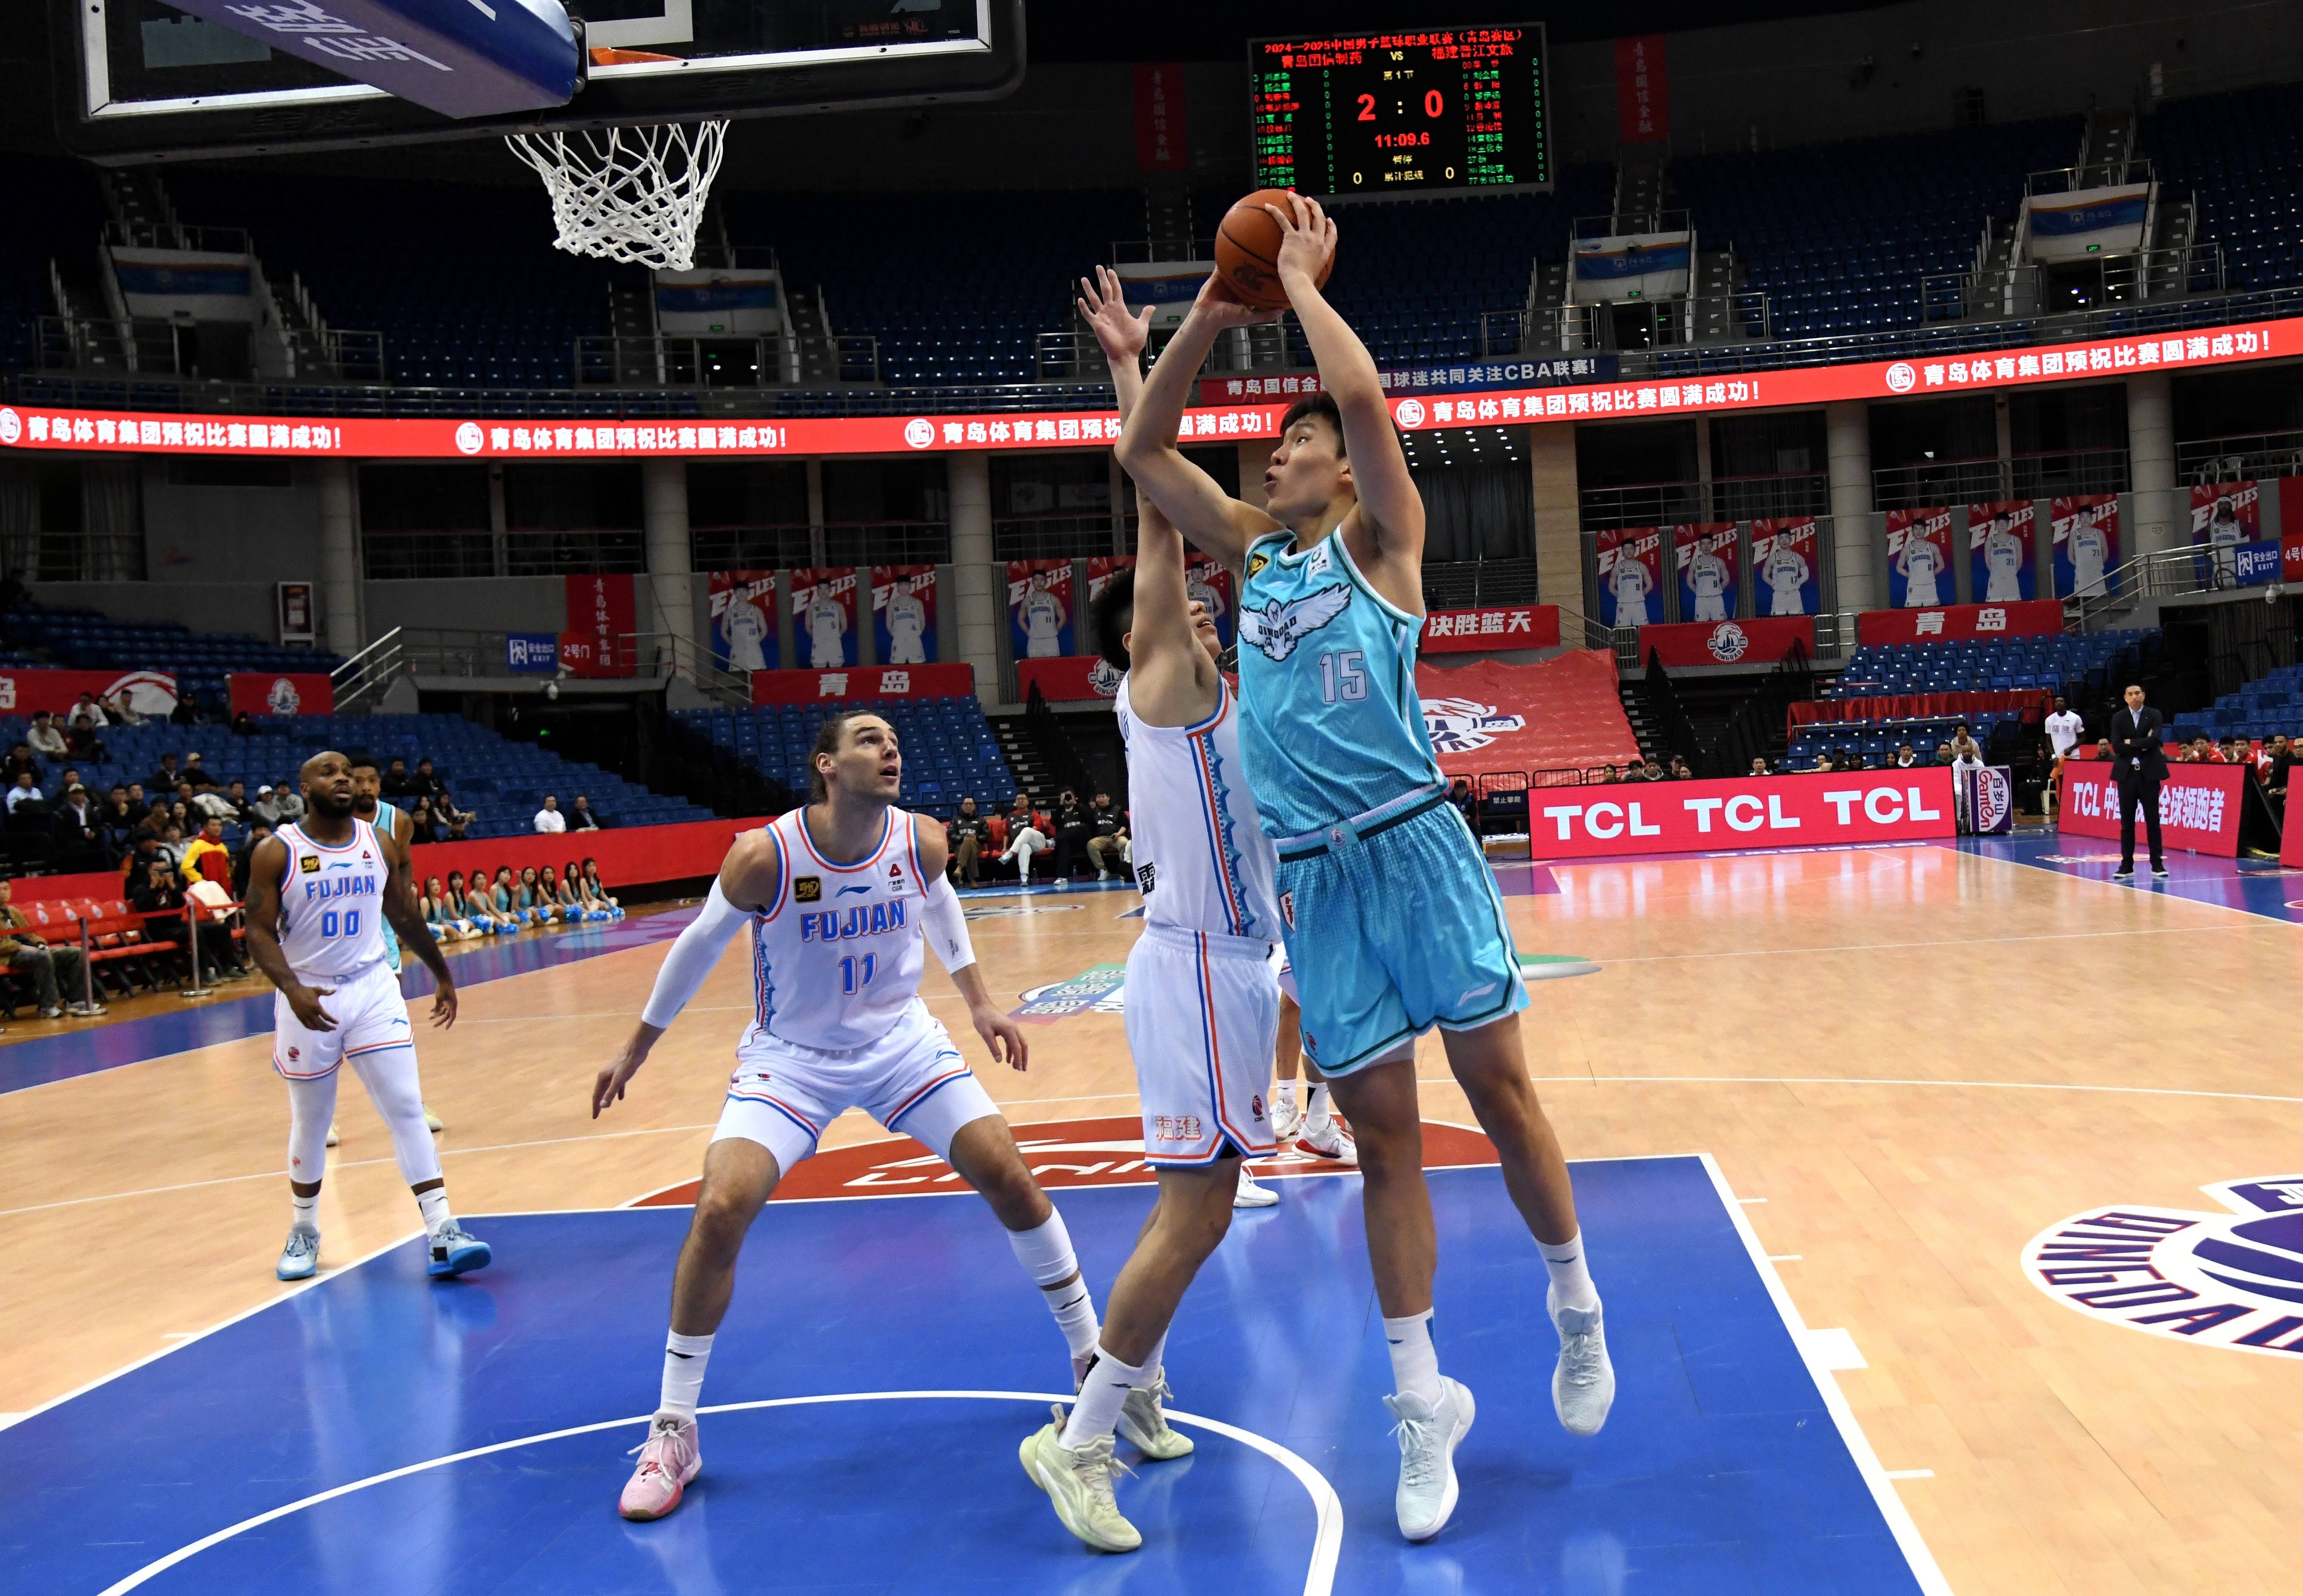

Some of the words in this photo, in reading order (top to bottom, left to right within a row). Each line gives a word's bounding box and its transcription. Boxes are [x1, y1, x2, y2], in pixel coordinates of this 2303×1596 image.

[1282, 51, 1362, 68] 青岛国信制药
[1390, 51, 1403, 60] VS
[1432, 43, 1513, 60] 福建晋江文旅
[1375, 132, 1430, 147] 11:09.6
[1353, 173, 1362, 184] 0
[1385, 170, 1424, 181] 累计犯规
[1445, 167, 1454, 179] 0
[2253, 551, 2277, 563] 安全出口
[593, 578, 611, 666] 青岛体育集团
[1429, 611, 1531, 637] 决胜篮天
[564, 644, 589, 658] 2号门
[1319, 651, 1367, 703] 15
[1993, 778, 2004, 814] 百岁山
[2073, 782, 2100, 817] TCL
[1544, 802, 1660, 840] TCL
[1684, 794, 1800, 832] TCL
[1824, 787, 1940, 825] TCL
[305, 875, 377, 901] FUJIAN
[322, 909, 362, 939] 00
[801, 899, 907, 942] FUJIAN
[1155, 1115, 1202, 1141] 福建
